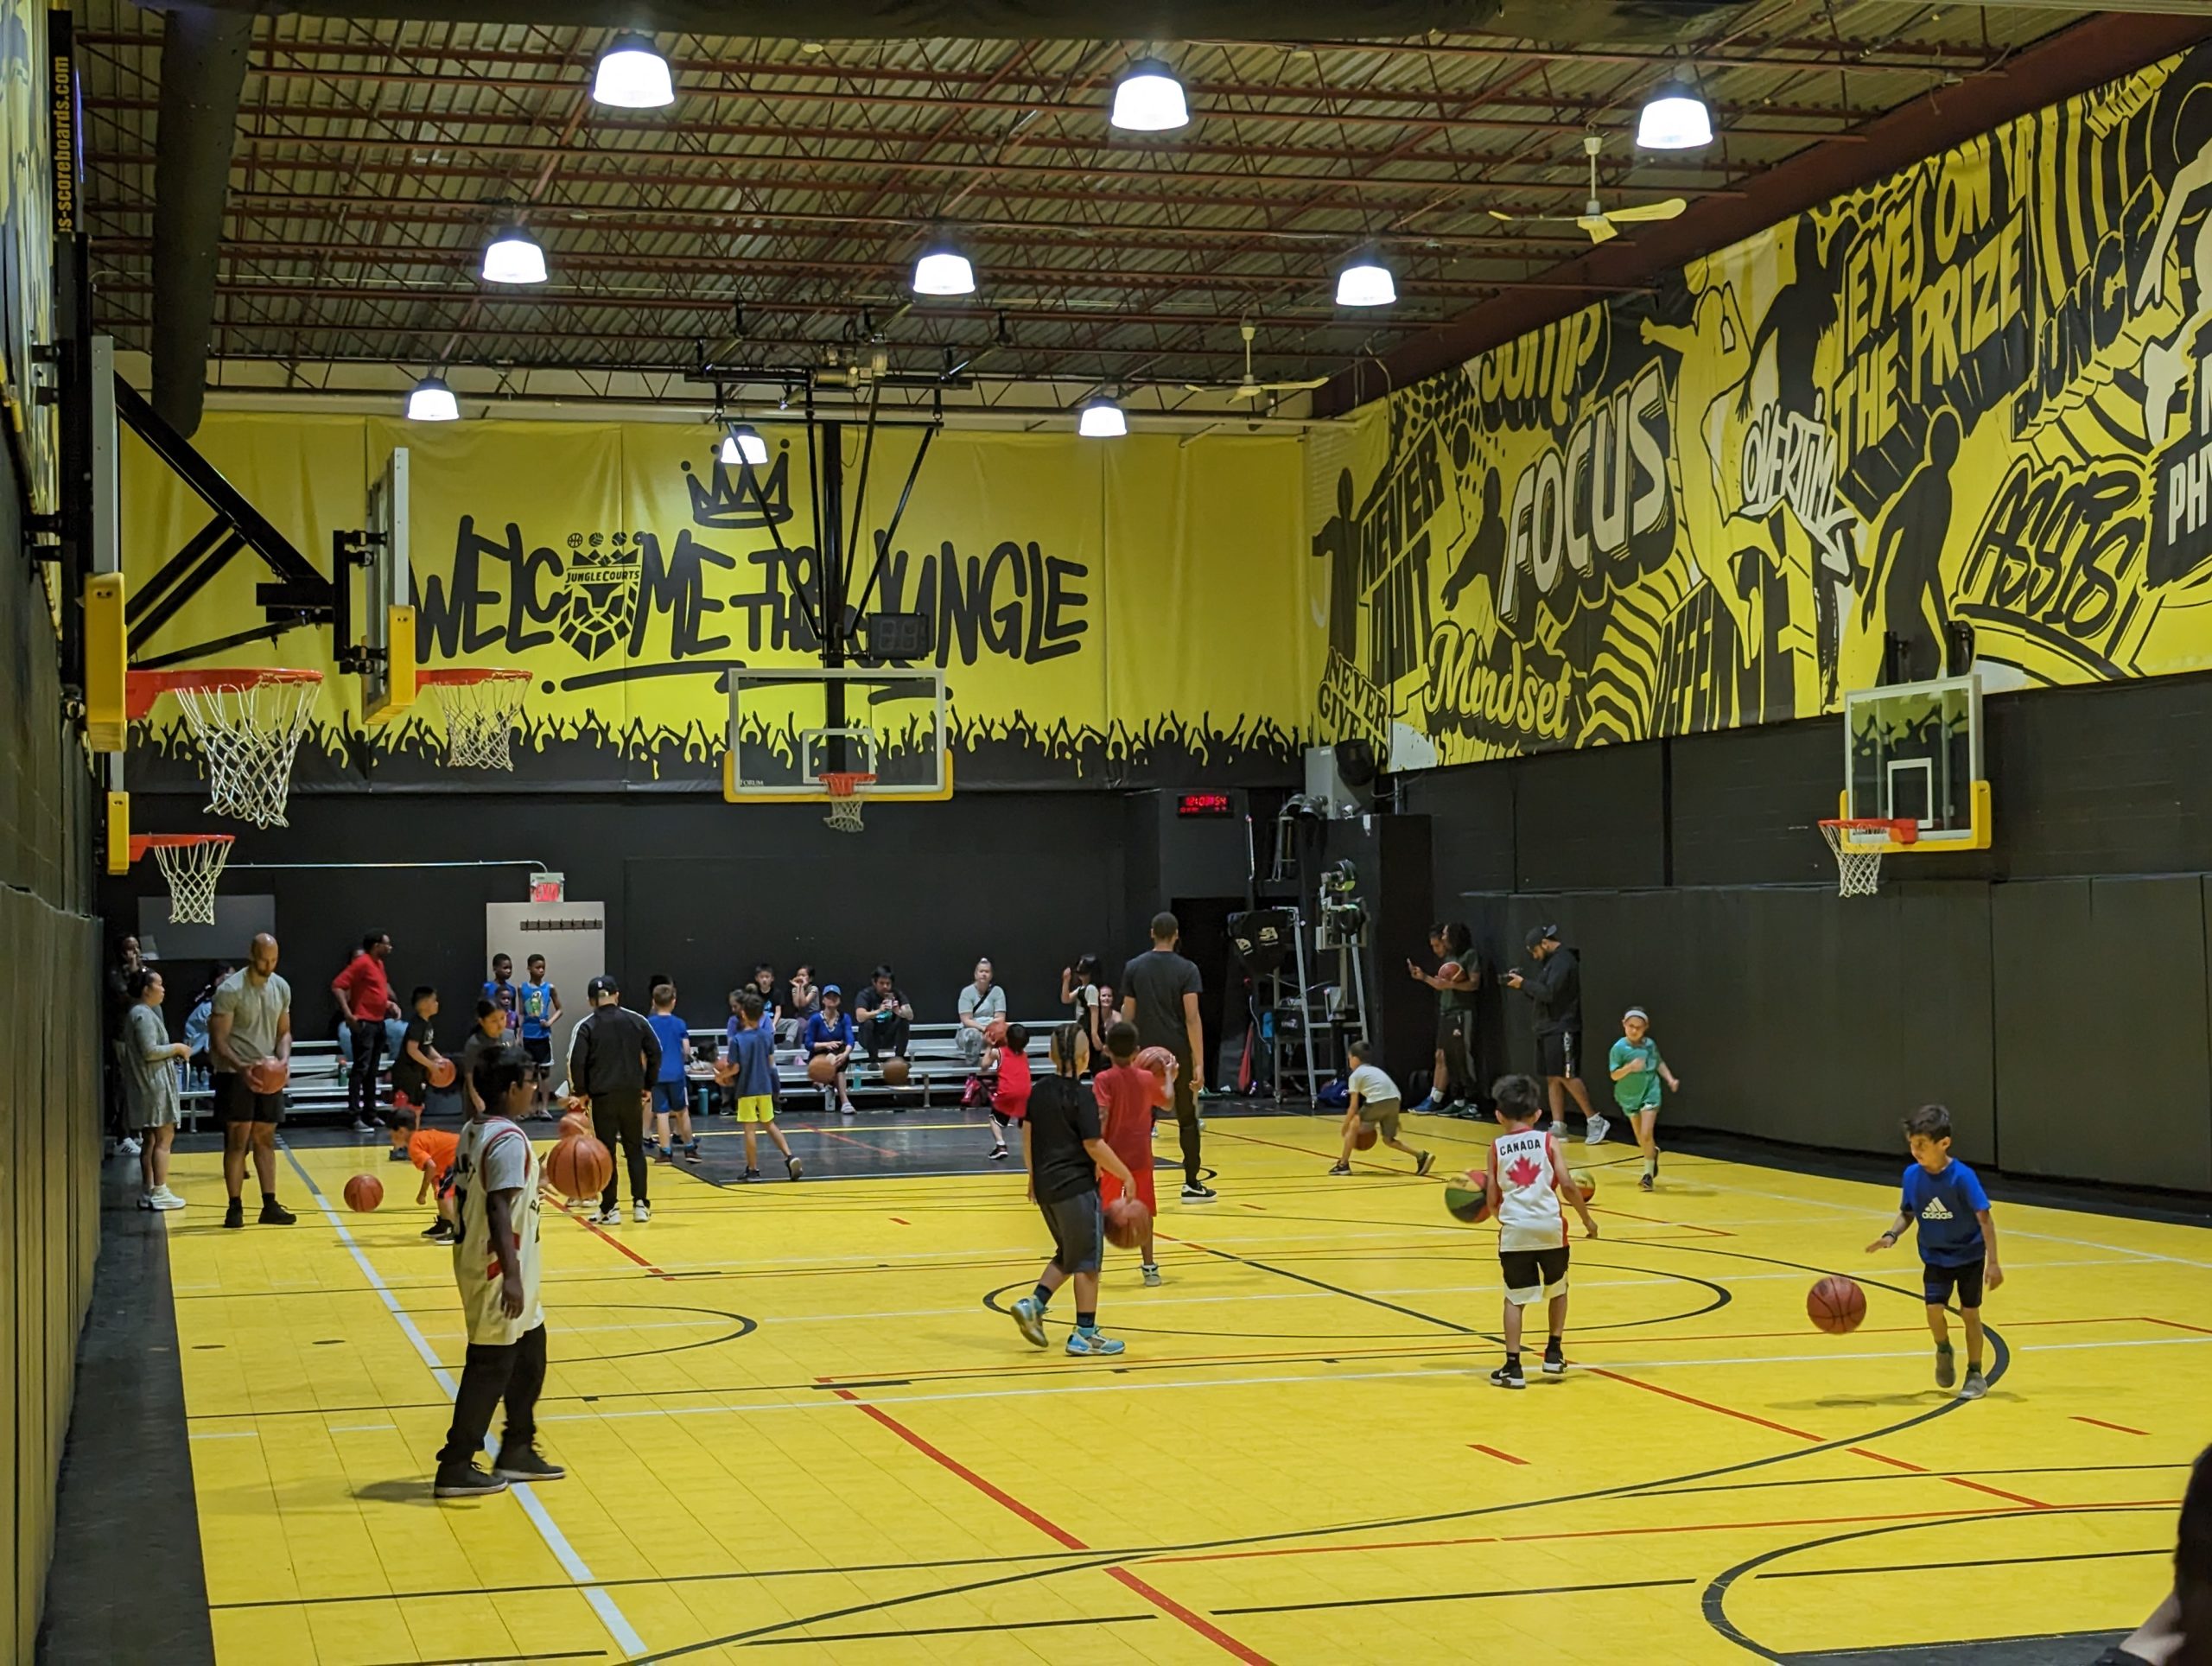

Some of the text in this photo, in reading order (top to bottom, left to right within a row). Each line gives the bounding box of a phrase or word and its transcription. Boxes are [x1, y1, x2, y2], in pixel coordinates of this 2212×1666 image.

[54, 56, 73, 232] s-scoreboards.com
[1848, 134, 1991, 357] EYES ON
[1835, 329, 1899, 481] THE
[1912, 208, 2023, 405] PRIZE
[1361, 427, 1445, 596] NEVER
[1500, 369, 1668, 619] FOCUS
[1326, 647, 1387, 738] NEVER
[1425, 624, 1573, 741] Mindset
[1499, 1139, 1541, 1156] CANADA
